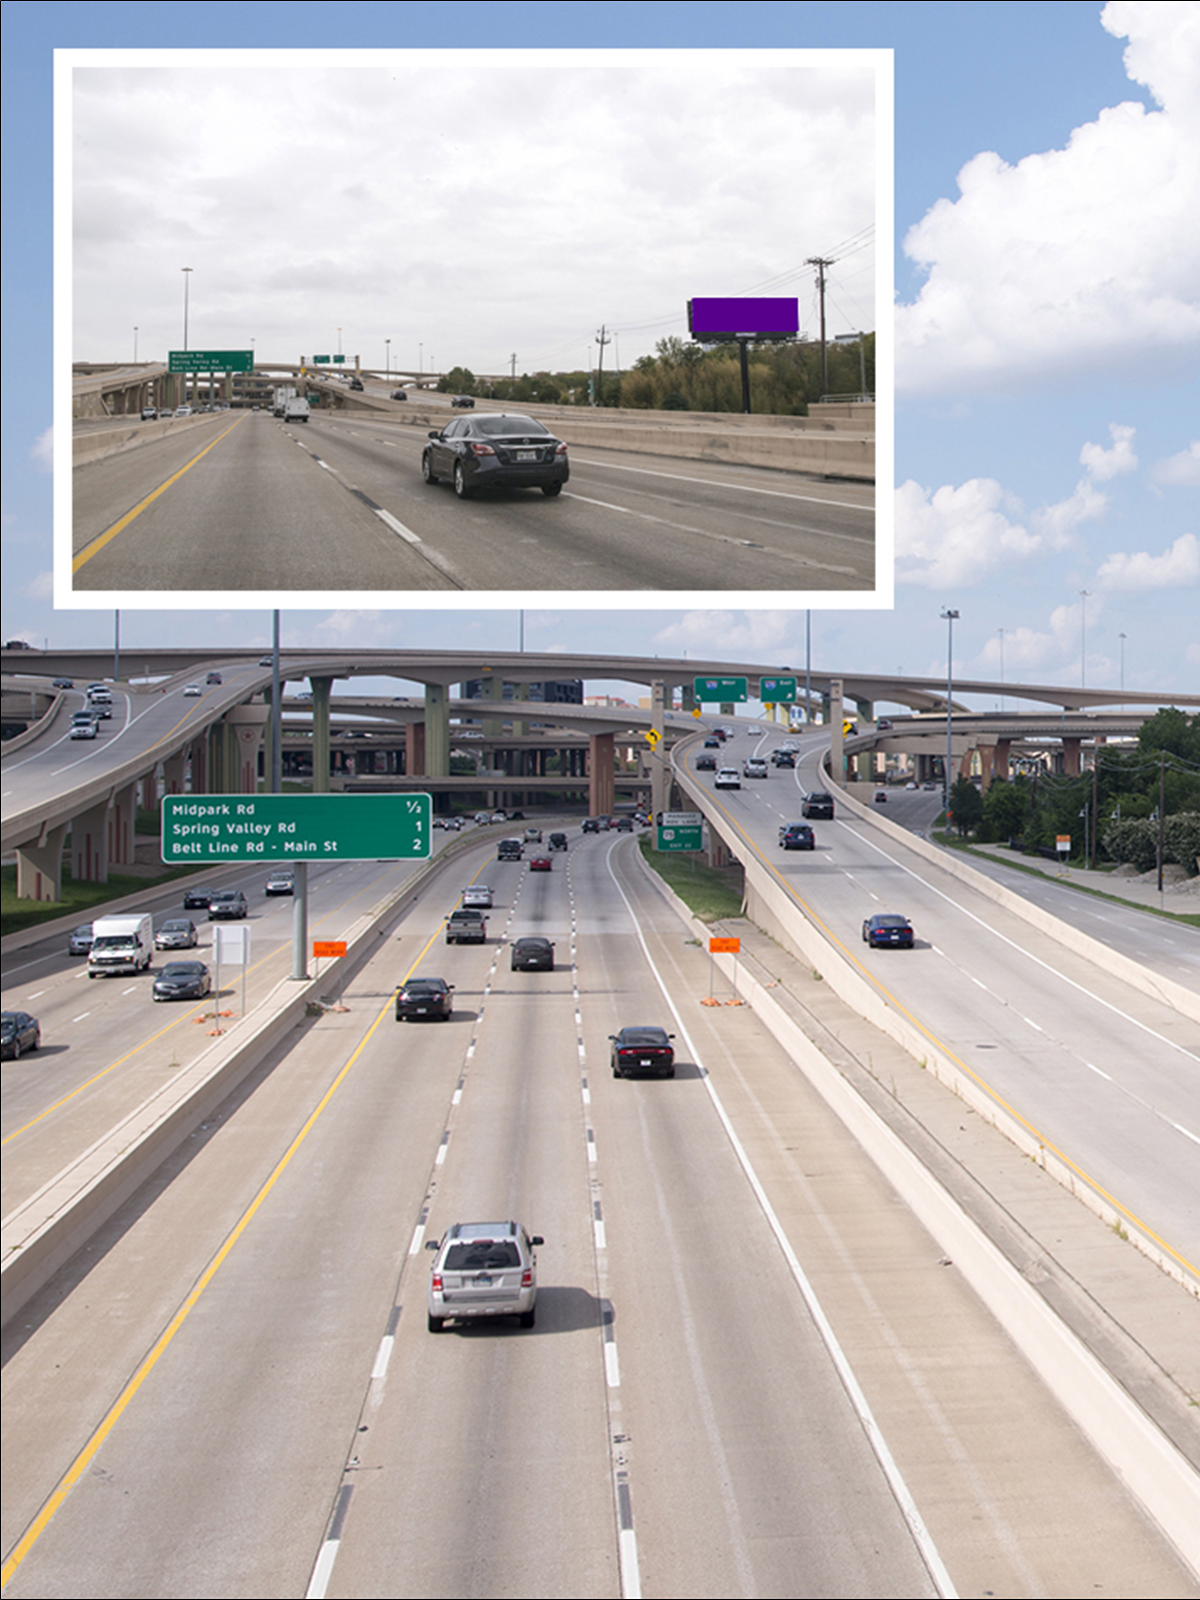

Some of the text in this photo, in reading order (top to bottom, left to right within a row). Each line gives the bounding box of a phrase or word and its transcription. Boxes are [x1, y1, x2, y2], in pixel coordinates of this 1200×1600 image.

[172, 804, 230, 818] Midpark
[236, 803, 255, 815] Rd
[172, 820, 422, 837] Spring Valley Rd 1
[172, 842, 202, 854] Belt
[208, 842, 239, 853] Line
[246, 841, 264, 852] Rd
[284, 840, 318, 851] Main
[323, 840, 338, 851] St
[413, 838, 422, 850] 2
